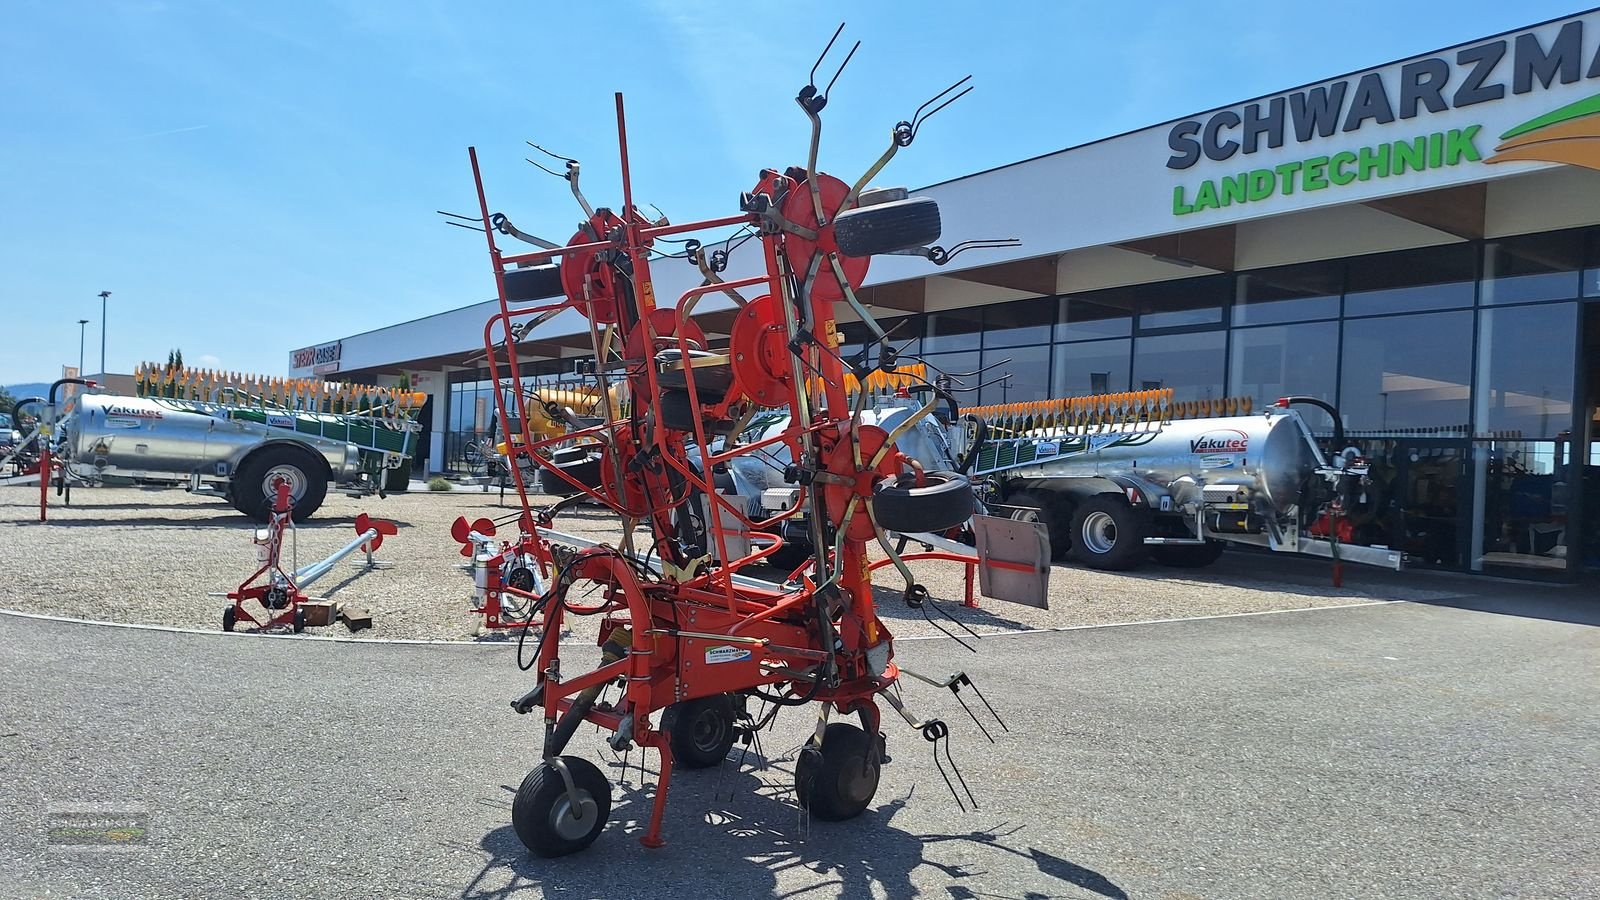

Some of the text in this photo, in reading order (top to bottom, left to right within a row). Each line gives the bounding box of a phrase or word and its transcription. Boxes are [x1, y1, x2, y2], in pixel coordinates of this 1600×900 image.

[1166, 20, 1600, 170] SCHWARZM
[1172, 124, 1482, 216] LANDTECHNIK
[101, 404, 163, 416] Vakutec
[1190, 436, 1248, 453] Vakutec
